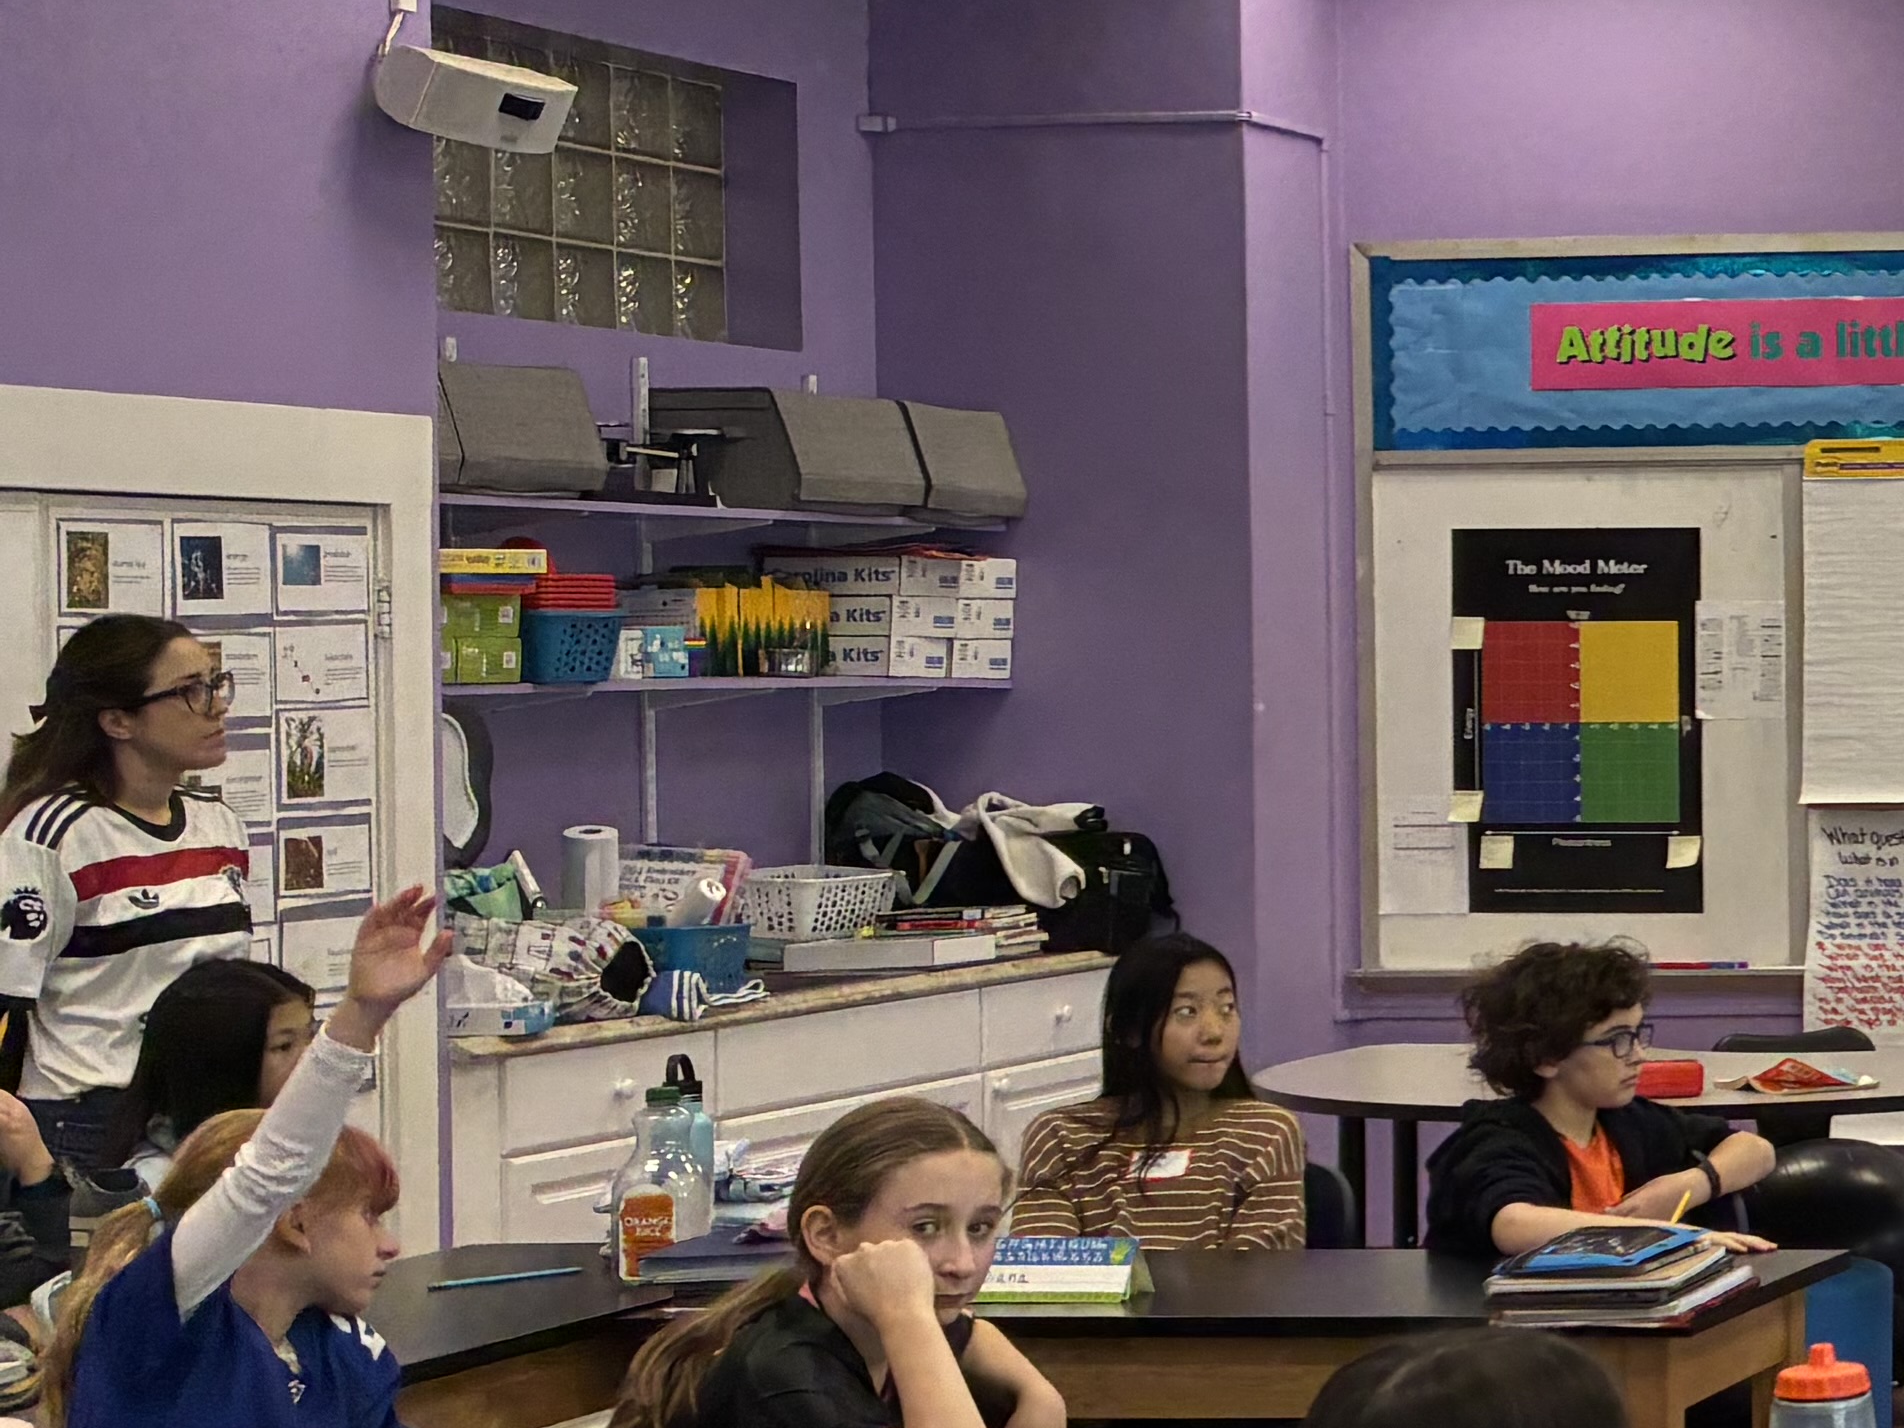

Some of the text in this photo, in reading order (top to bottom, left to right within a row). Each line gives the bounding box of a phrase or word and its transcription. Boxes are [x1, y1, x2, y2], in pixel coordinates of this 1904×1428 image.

[1557, 324, 1735, 363] Attitude
[1750, 323, 1782, 359] is
[1796, 327, 1820, 358] a
[854, 567, 888, 582] Kits
[1505, 559, 1648, 575] The Mood Meter
[847, 608, 879, 623] Kits
[843, 648, 876, 662] Kits
[1821, 827, 1866, 846] What
[624, 1216, 672, 1226] ORANGE
